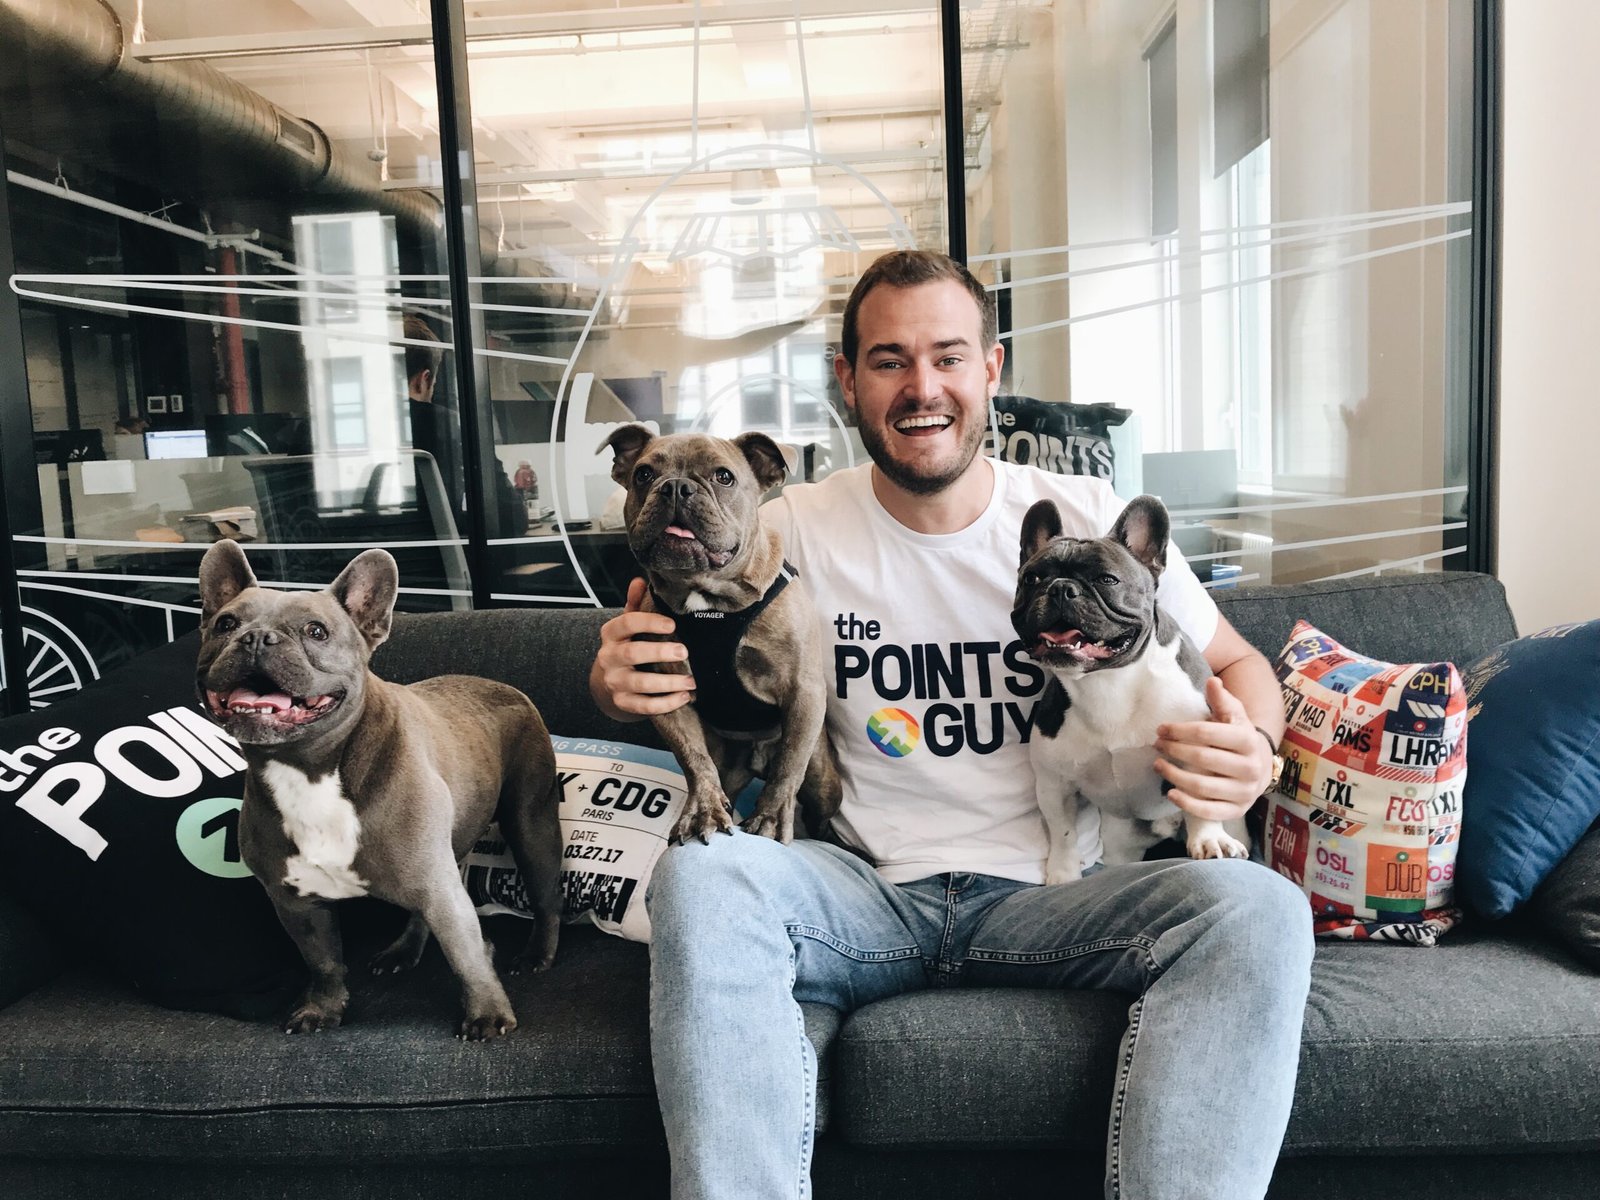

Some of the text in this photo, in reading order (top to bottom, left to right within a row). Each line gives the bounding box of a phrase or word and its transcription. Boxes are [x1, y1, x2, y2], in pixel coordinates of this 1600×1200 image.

[694, 611, 724, 619] VOYAGER
[834, 612, 881, 641] the
[834, 639, 1046, 701] POINTS
[1408, 671, 1449, 694] CPH
[923, 700, 1041, 758] GUY
[1297, 702, 1326, 729] MAD
[574, 742, 623, 756] PASS
[1332, 723, 1372, 753] AMS
[1389, 734, 1440, 766] LHR
[610, 762, 624, 772] TO
[15, 706, 249, 862] POIN
[556, 771, 672, 819] K CDG
[1325, 777, 1355, 809] TXL
[580, 807, 615, 822] PARIS
[1385, 795, 1427, 822] FCO
[570, 829, 600, 843] DATE
[1273, 824, 1297, 857] ZRH
[563, 844, 624, 864] 03.27.17
[1315, 846, 1354, 876] OSL
[1386, 862, 1423, 894] DUB
